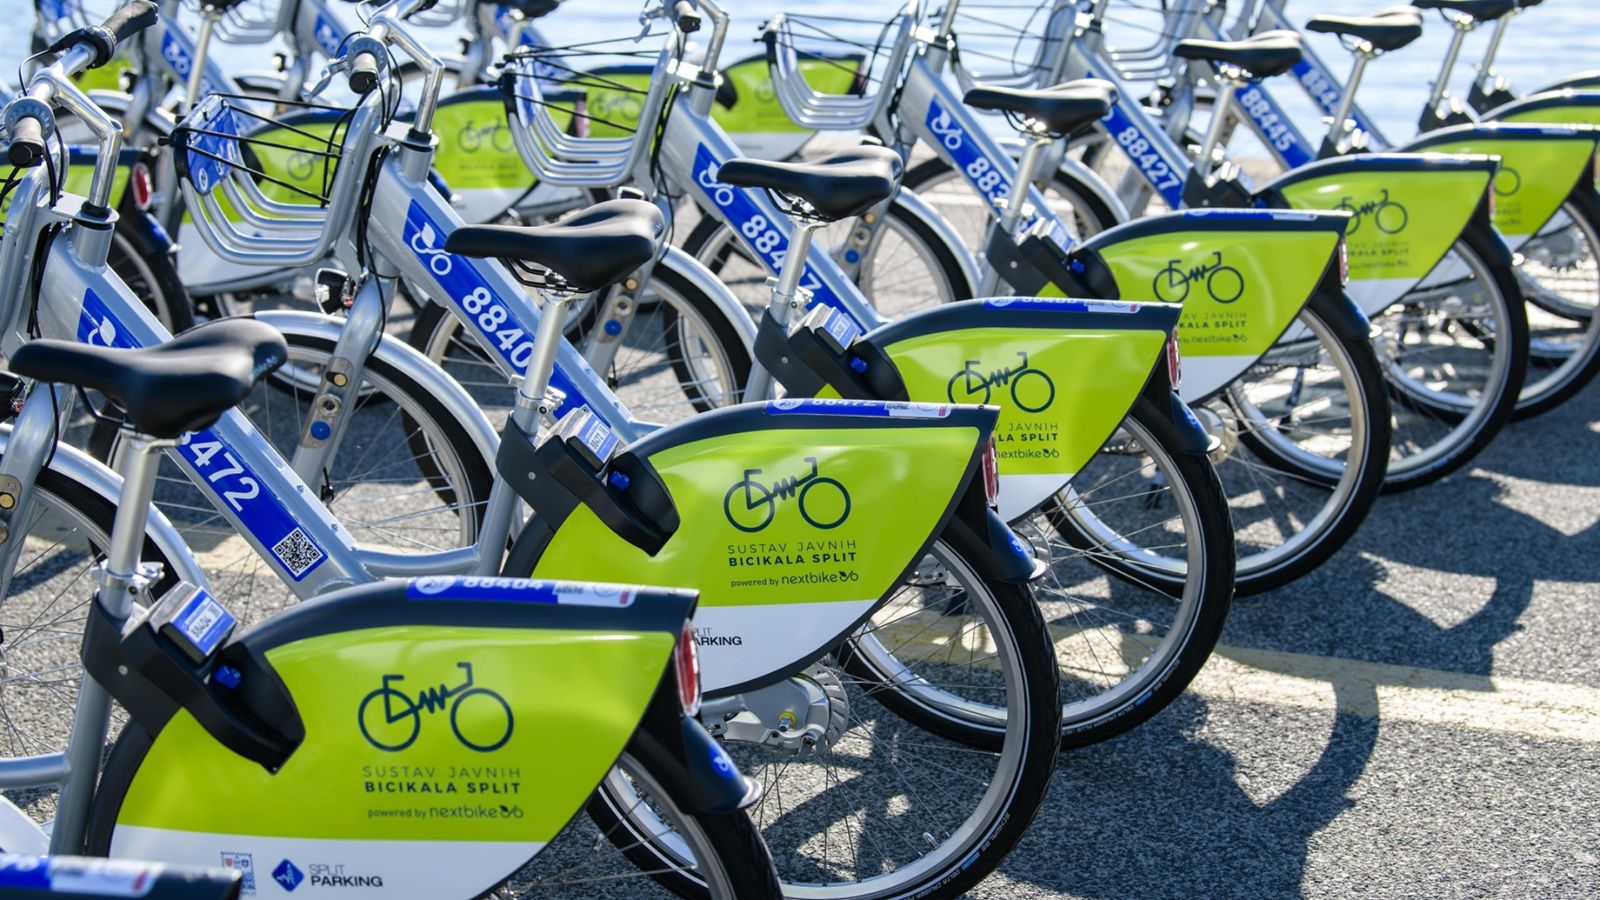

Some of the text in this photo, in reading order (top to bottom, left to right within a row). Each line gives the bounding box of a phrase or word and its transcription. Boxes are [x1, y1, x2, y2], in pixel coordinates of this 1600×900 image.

[1117, 126, 1180, 190] 88427
[742, 214, 822, 290] 8847
[1215, 320, 1246, 328] SPLIT
[462, 286, 554, 377] 8840
[1009, 422, 1058, 431] JAVNIH
[1021, 433, 1058, 441] SPLIT
[728, 540, 856, 554] SUSTAV JAVNIH
[729, 552, 856, 567] BICIKALA SPLIT
[731, 572, 838, 588] powered by nextbike
[363, 766, 520, 778] SUSTAV JAVNIH
[365, 782, 520, 794] BICIKALA SPLIT
[368, 804, 497, 819] powered by nextbike
[308, 863, 345, 876] SPLIT
[311, 876, 383, 888] PARKING
